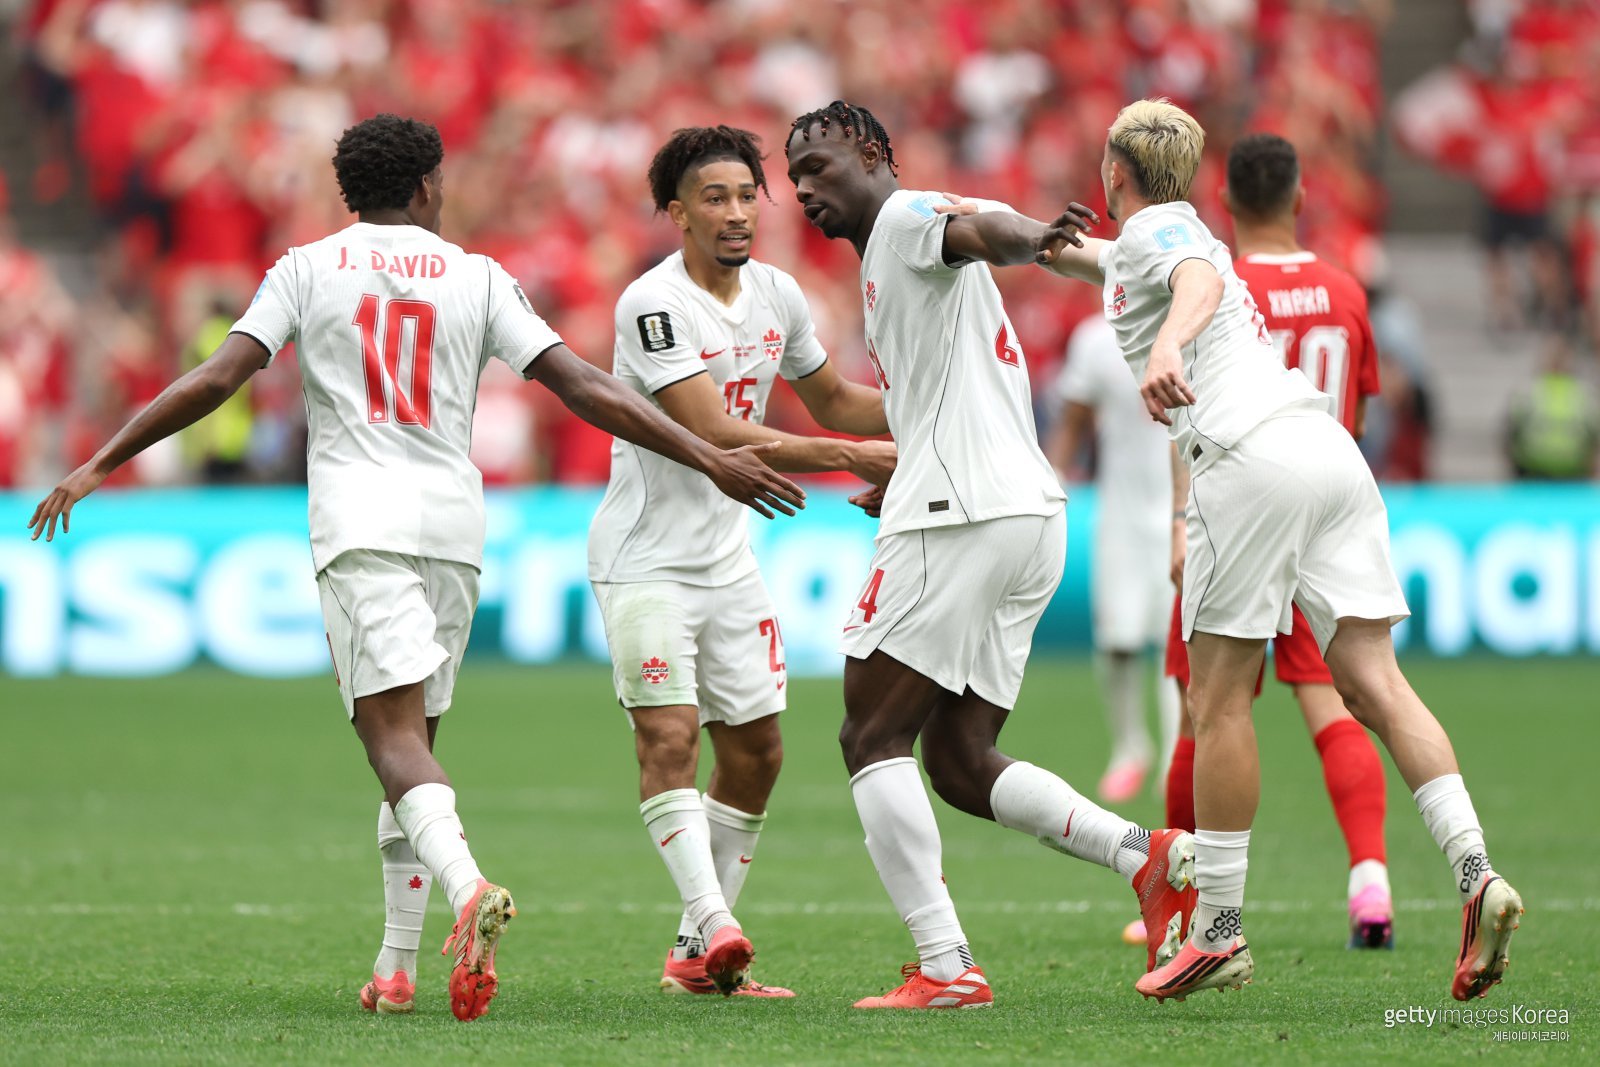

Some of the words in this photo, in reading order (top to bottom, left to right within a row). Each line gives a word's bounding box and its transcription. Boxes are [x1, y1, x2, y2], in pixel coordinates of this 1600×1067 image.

[337, 246, 357, 271] J.
[370, 249, 447, 279] DAVID
[351, 293, 437, 431] 10
[851, 567, 885, 624] 4
[1387, 521, 1600, 657] na
[759, 617, 786, 673] 2
